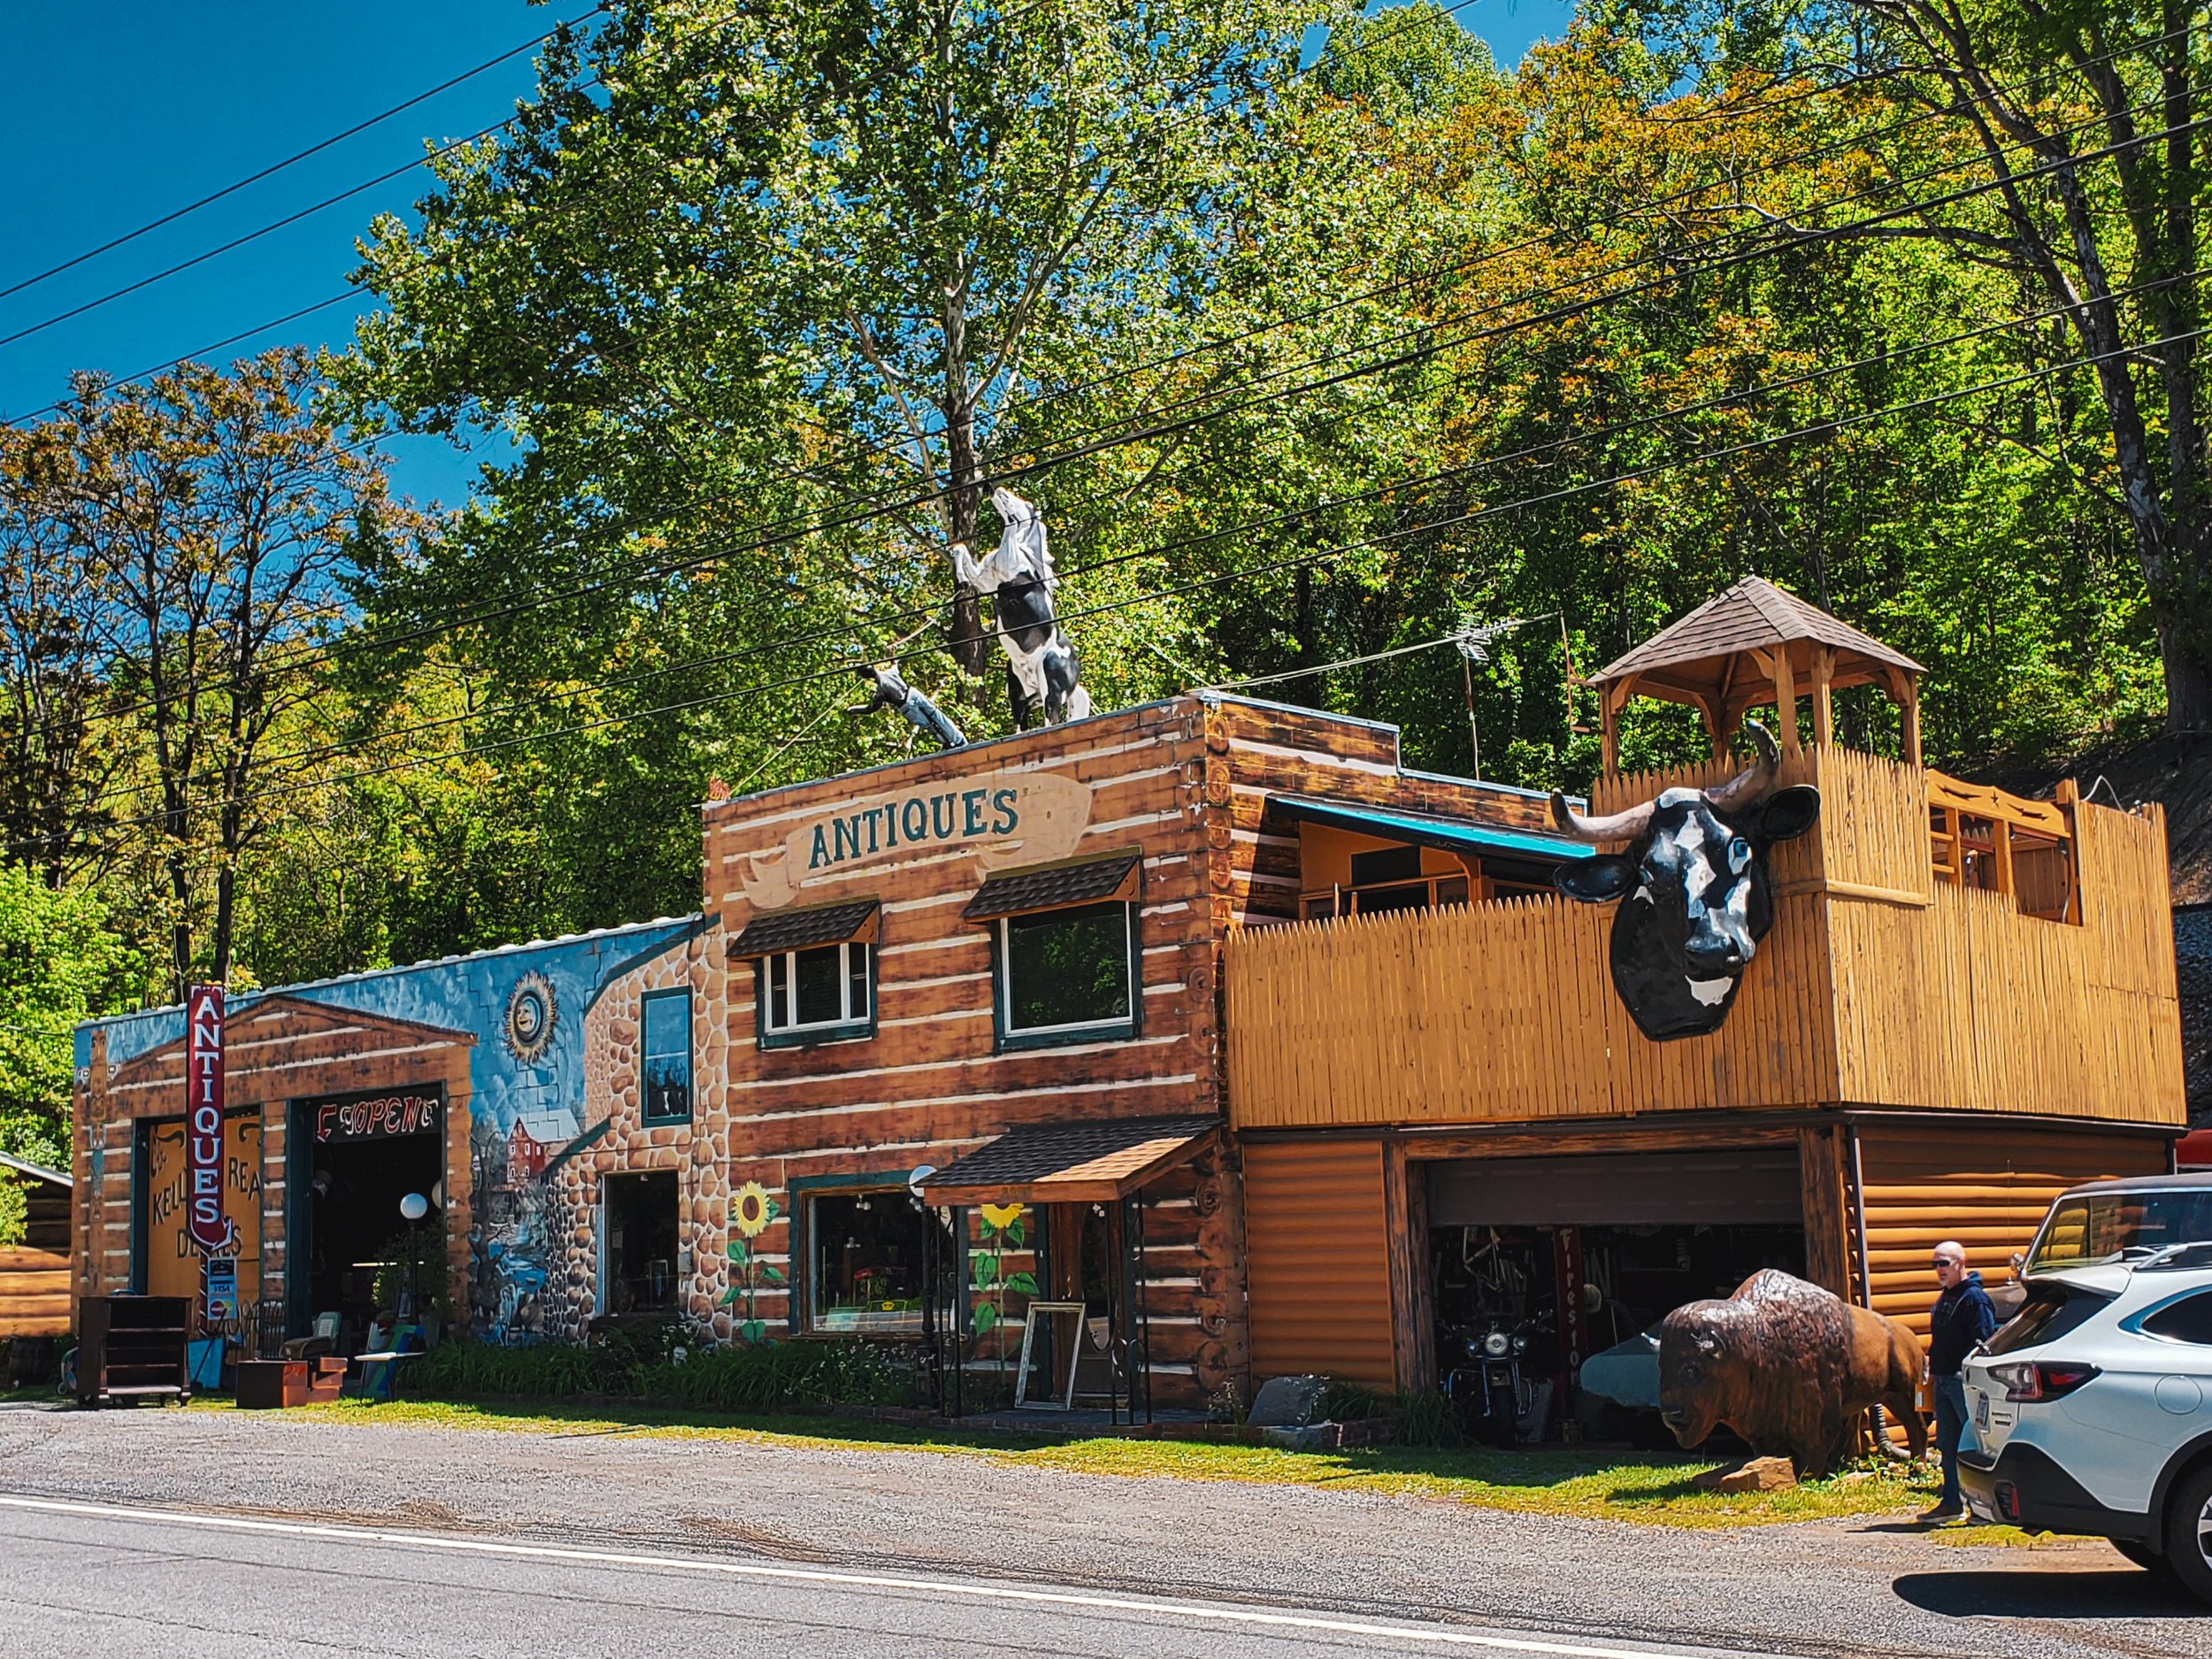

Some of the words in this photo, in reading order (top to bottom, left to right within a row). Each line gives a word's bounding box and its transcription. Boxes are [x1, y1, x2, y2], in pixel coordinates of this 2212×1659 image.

[808, 788, 1019, 870] ANTIQUES
[193, 995, 220, 1224] ANTIQUES
[353, 1096, 423, 1135] OPEN
[153, 1166, 188, 1226] KELL
